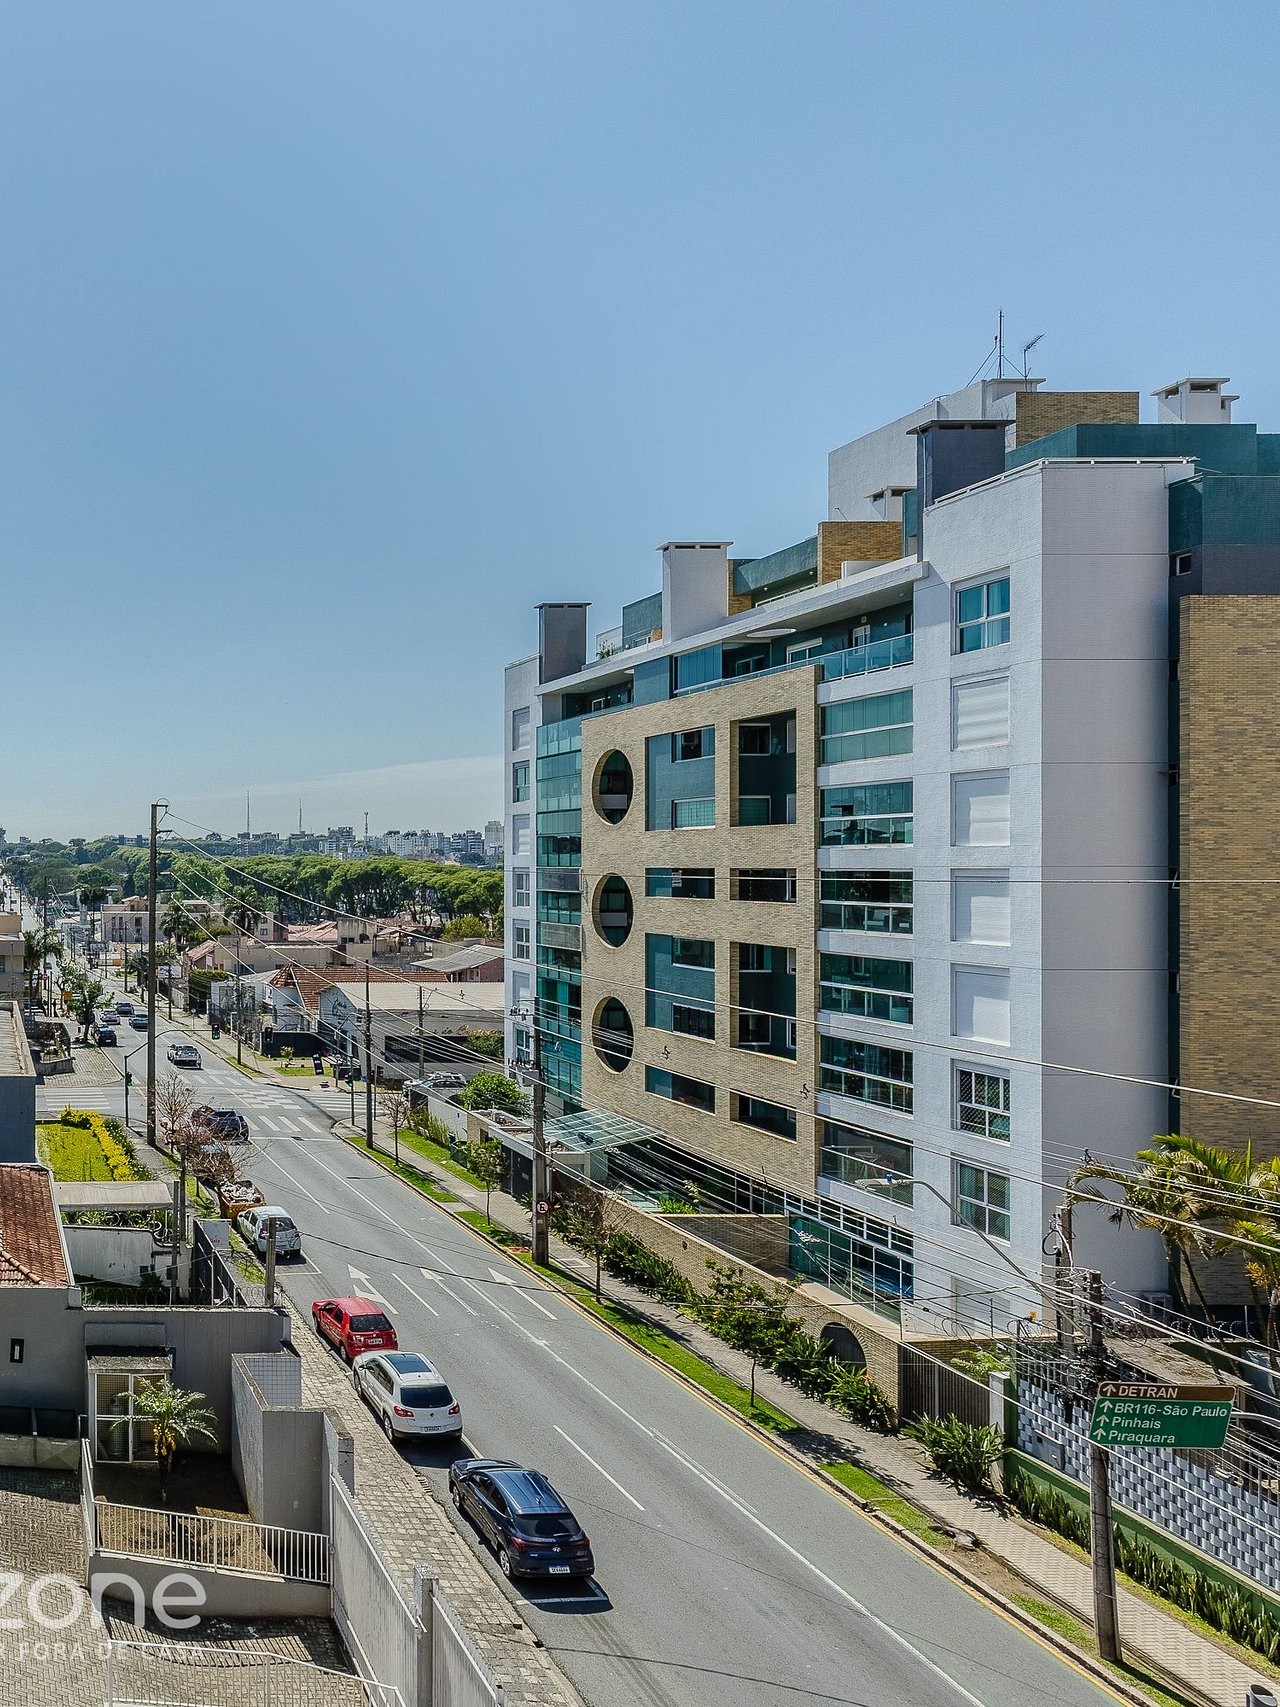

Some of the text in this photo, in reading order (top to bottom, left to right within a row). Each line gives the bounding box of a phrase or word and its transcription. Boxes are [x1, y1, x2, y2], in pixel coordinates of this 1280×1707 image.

[1118, 1385, 1178, 1399] DETRAN
[1114, 1402, 1228, 1417] BR116-São Paulo
[1111, 1416, 1162, 1429] Pinhais
[1108, 1430, 1176, 1445] Piraquara
